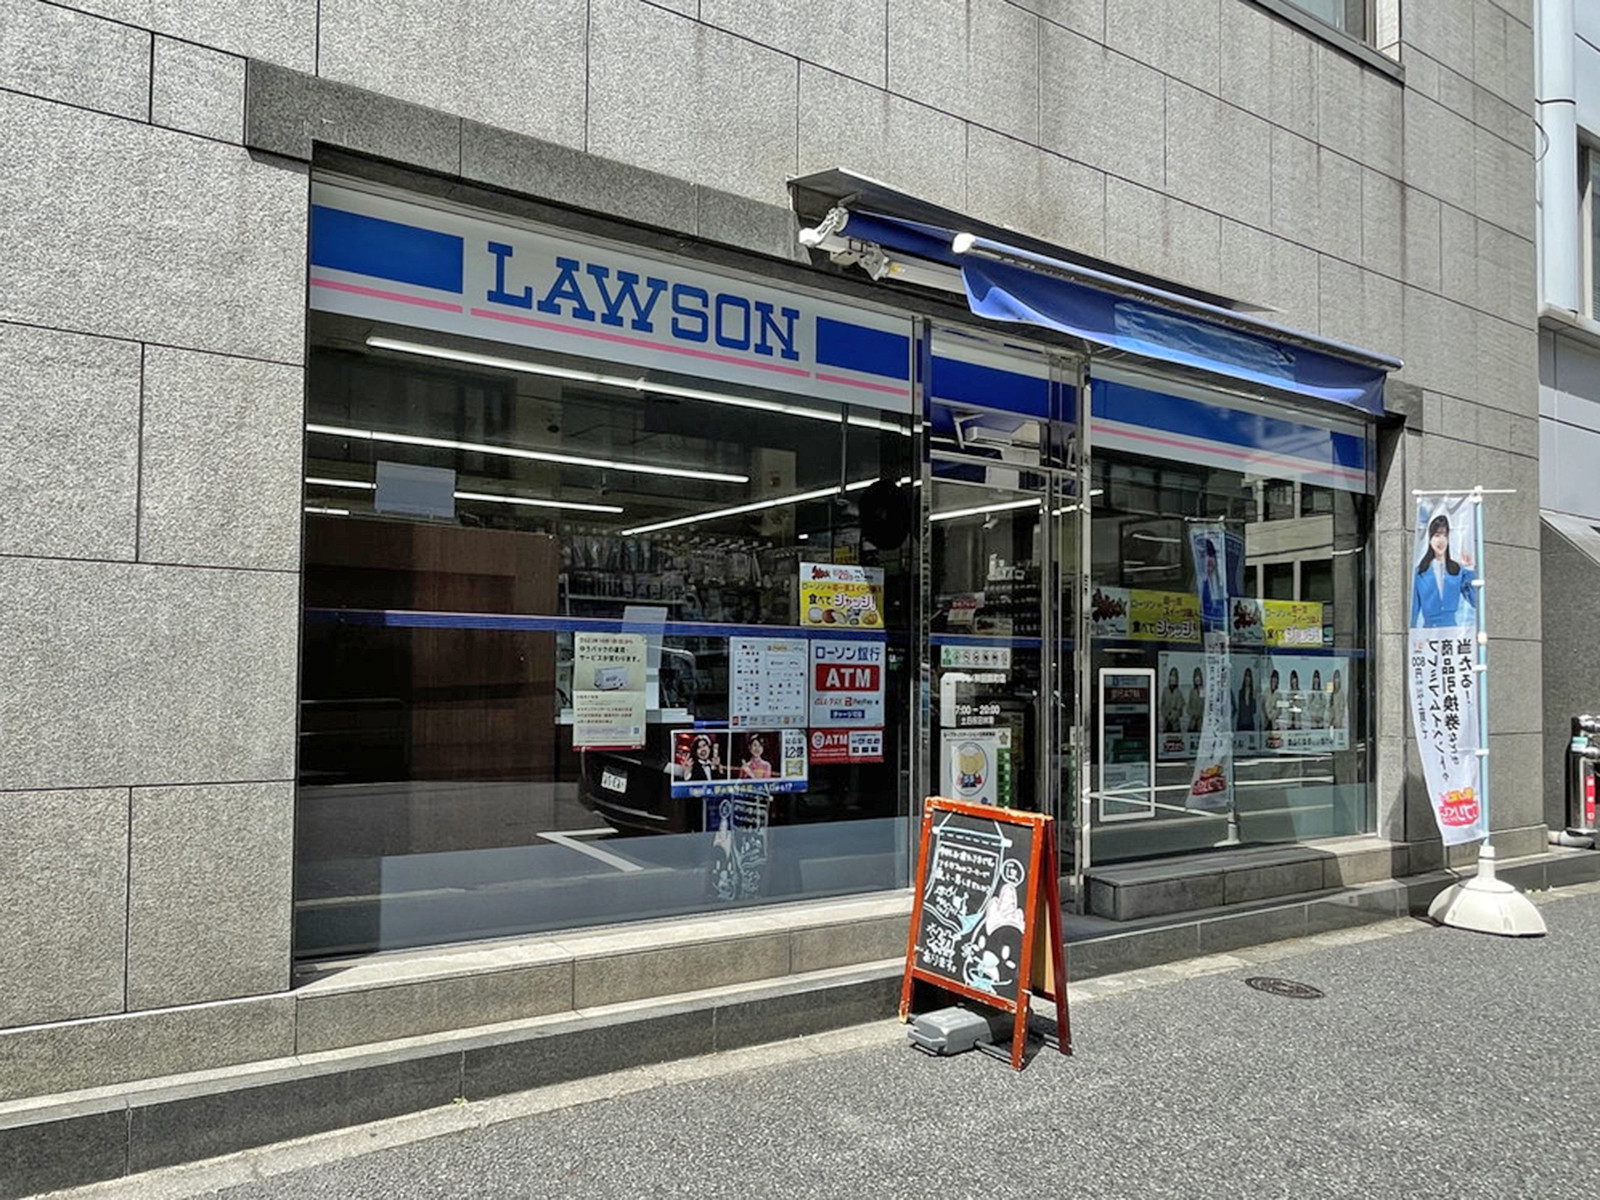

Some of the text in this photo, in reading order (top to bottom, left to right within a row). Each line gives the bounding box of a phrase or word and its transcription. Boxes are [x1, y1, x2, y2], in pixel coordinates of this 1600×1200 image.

[487, 240, 800, 362] LAWSON
[815, 646, 880, 661] ローソン銀行
[825, 667, 871, 688] ATM
